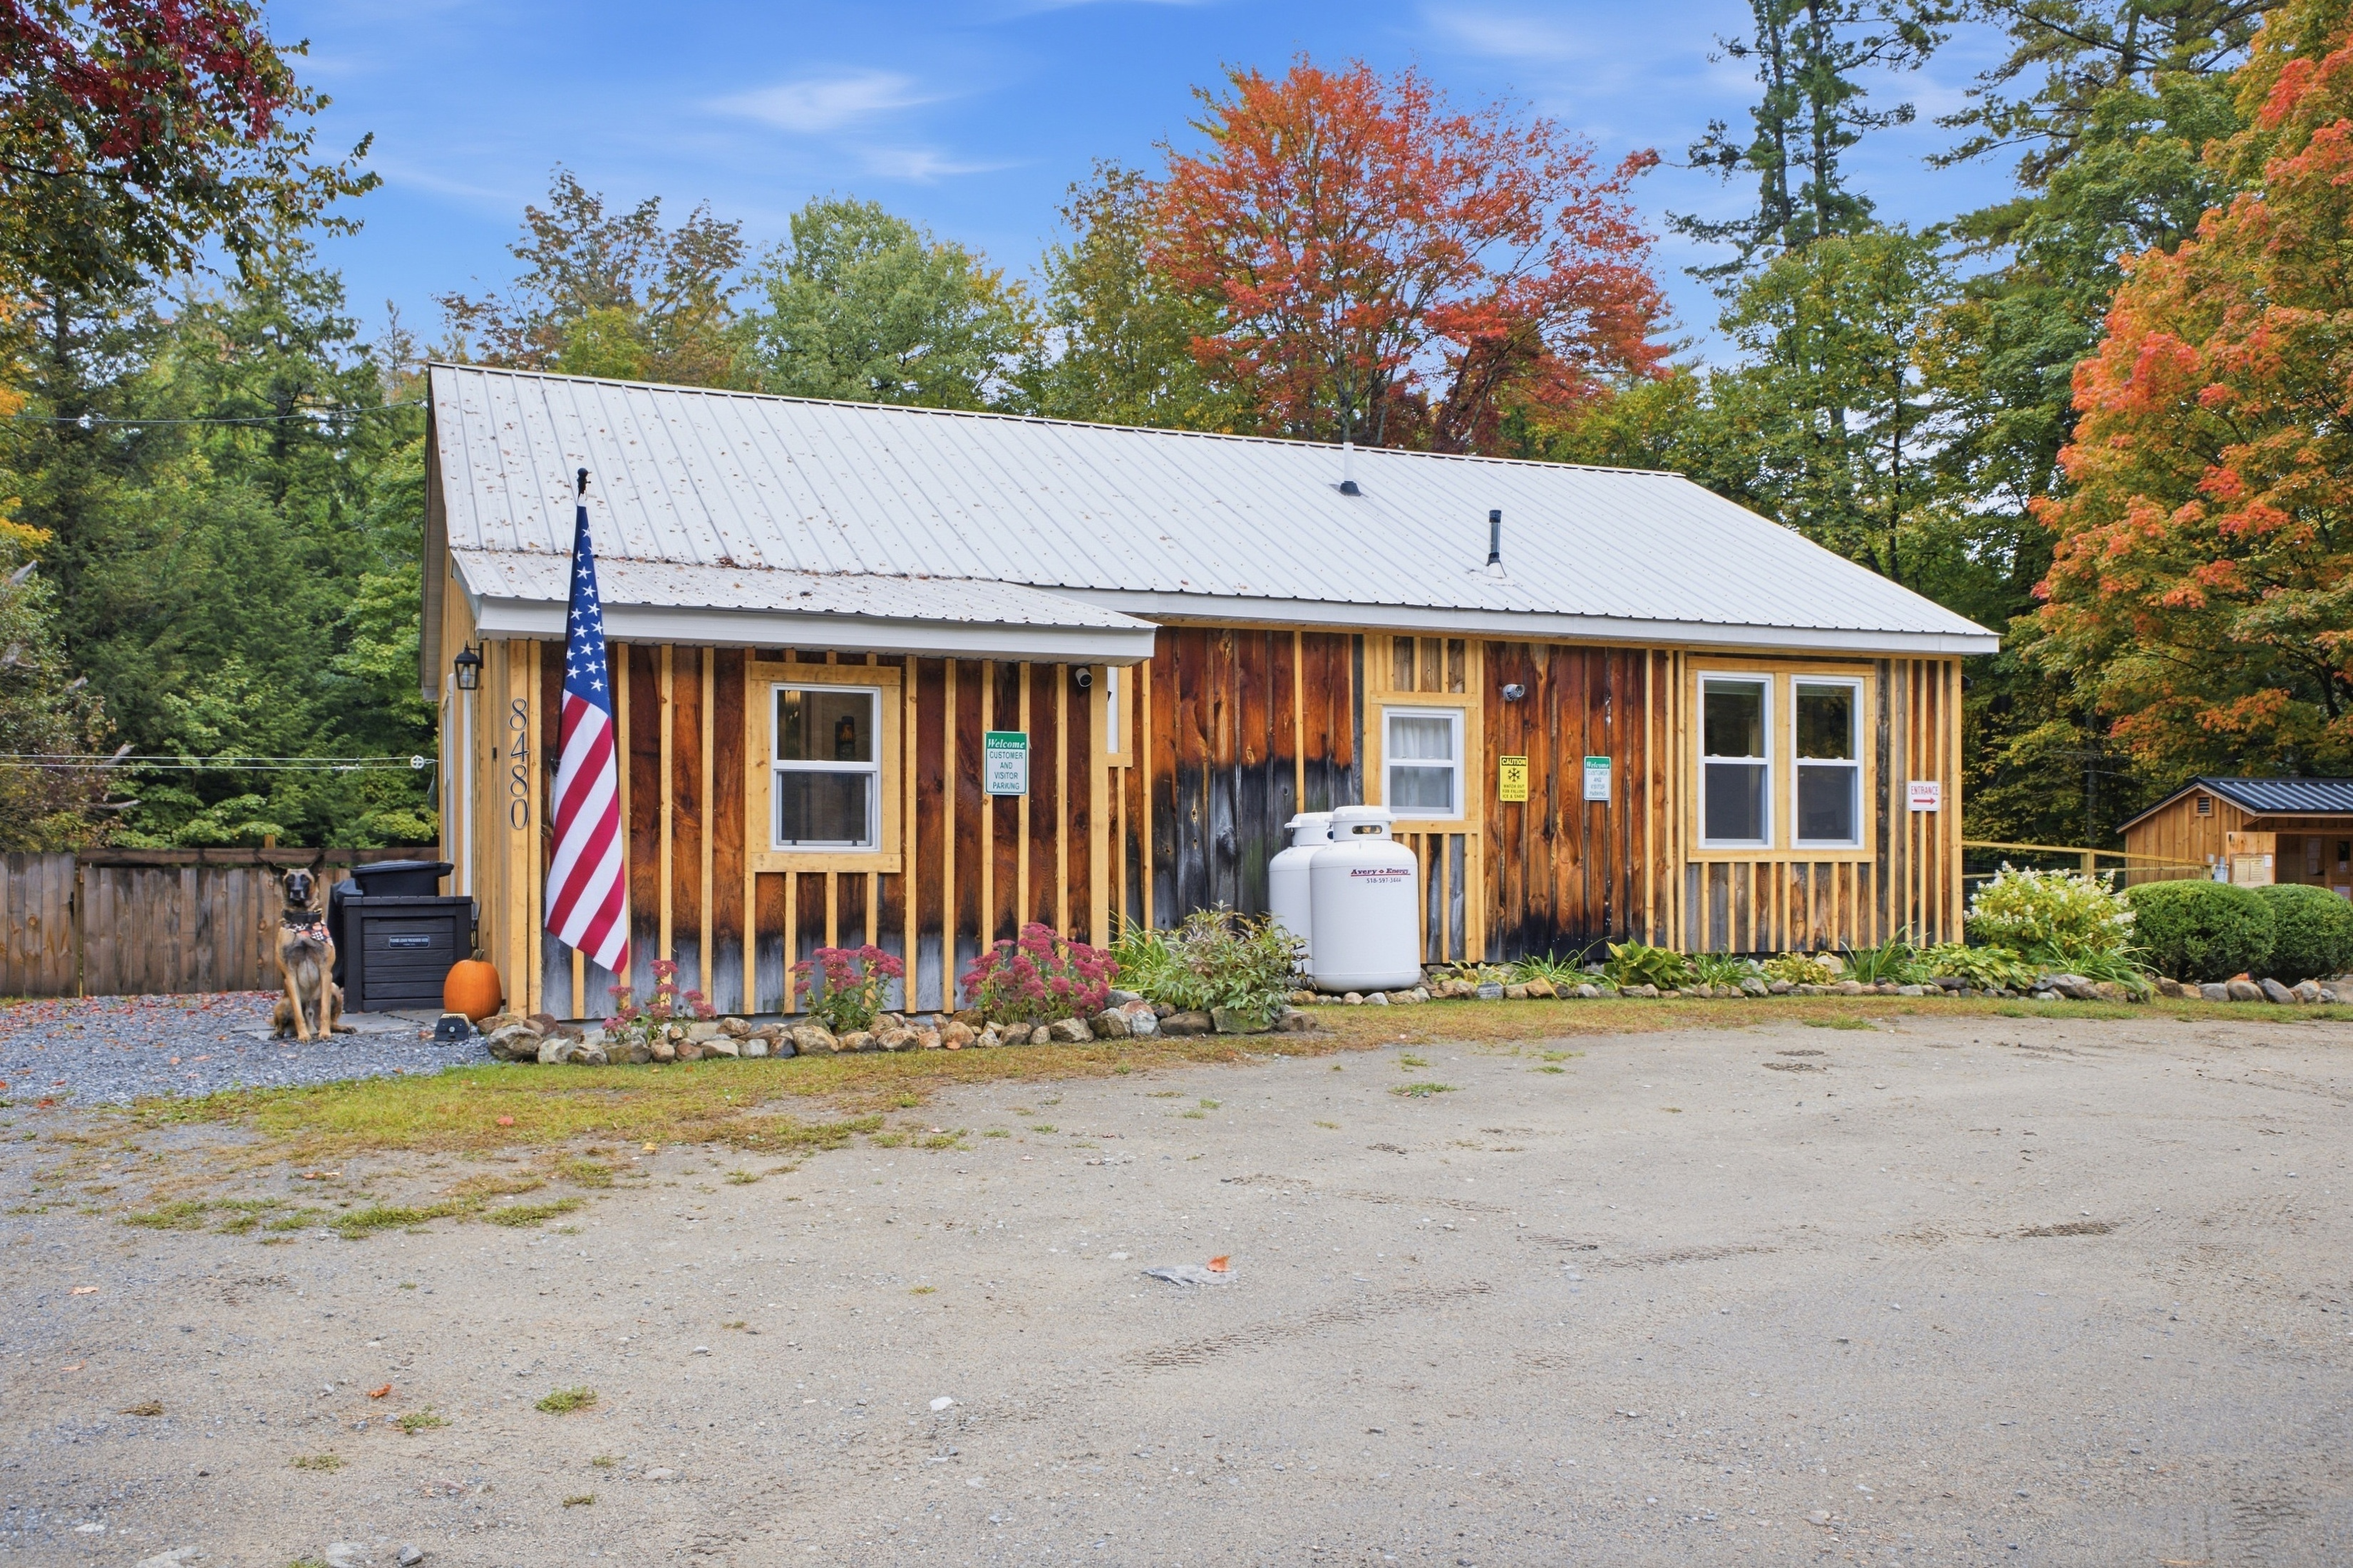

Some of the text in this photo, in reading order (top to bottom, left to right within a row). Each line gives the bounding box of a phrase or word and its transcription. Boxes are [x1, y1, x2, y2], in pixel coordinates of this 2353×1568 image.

[987, 738, 1025, 748] Welcome
[989, 751, 1023, 759] CUSTOMER
[509, 698, 529, 830] 8480
[1911, 786, 1938, 795] ENTRANCE
